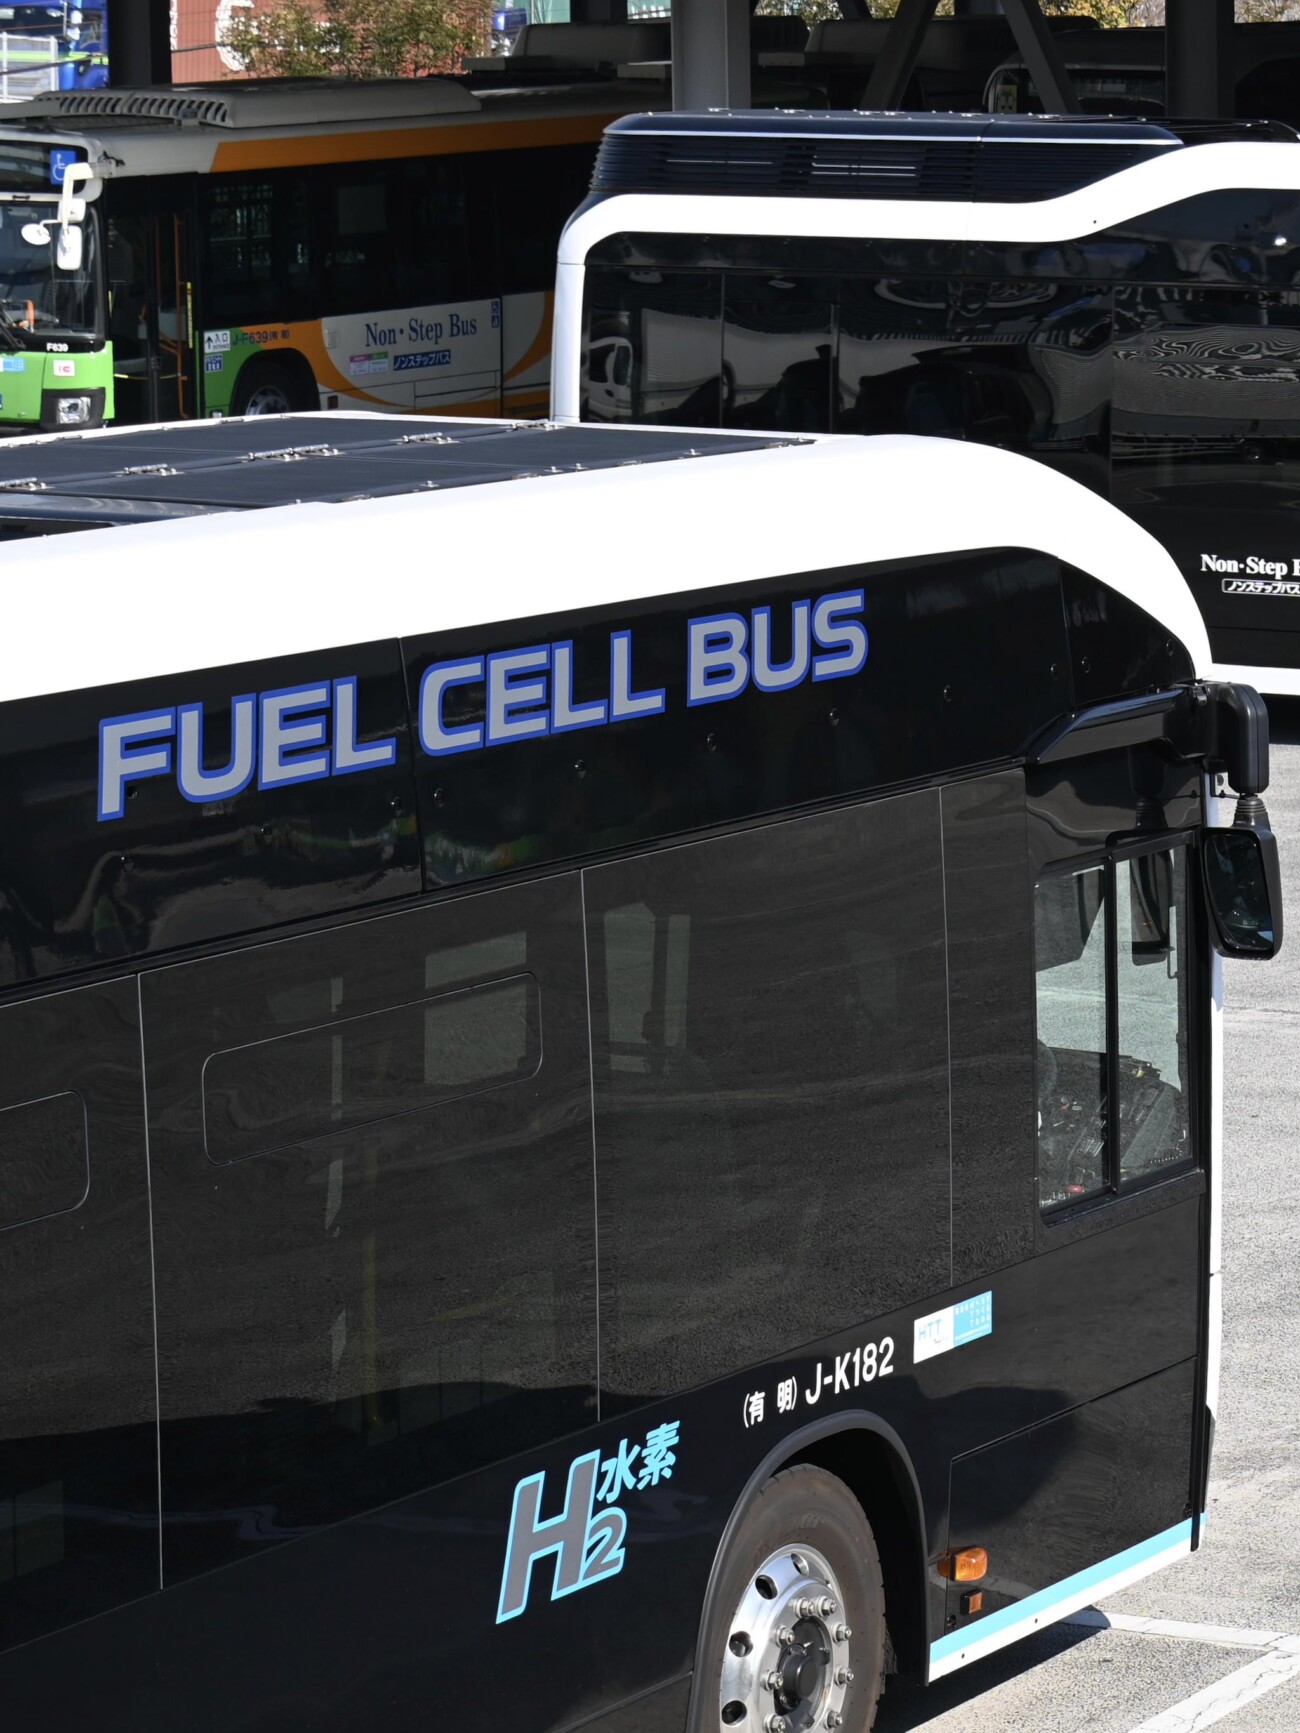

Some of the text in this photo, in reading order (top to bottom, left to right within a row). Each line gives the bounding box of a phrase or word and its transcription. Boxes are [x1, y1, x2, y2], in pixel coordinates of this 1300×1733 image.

[448, 312, 477, 338] Bus
[46, 342, 69, 352] F639
[214, 332, 228, 344] 入口
[232, 331, 269, 346] J-F639
[394, 352, 450, 369] ノンステップバス
[96, 588, 869, 822] FUEL CELL BUS
[918, 1318, 943, 1342] HTT
[805, 1336, 895, 1405] J-K182
[596, 1420, 680, 1504] 水素
